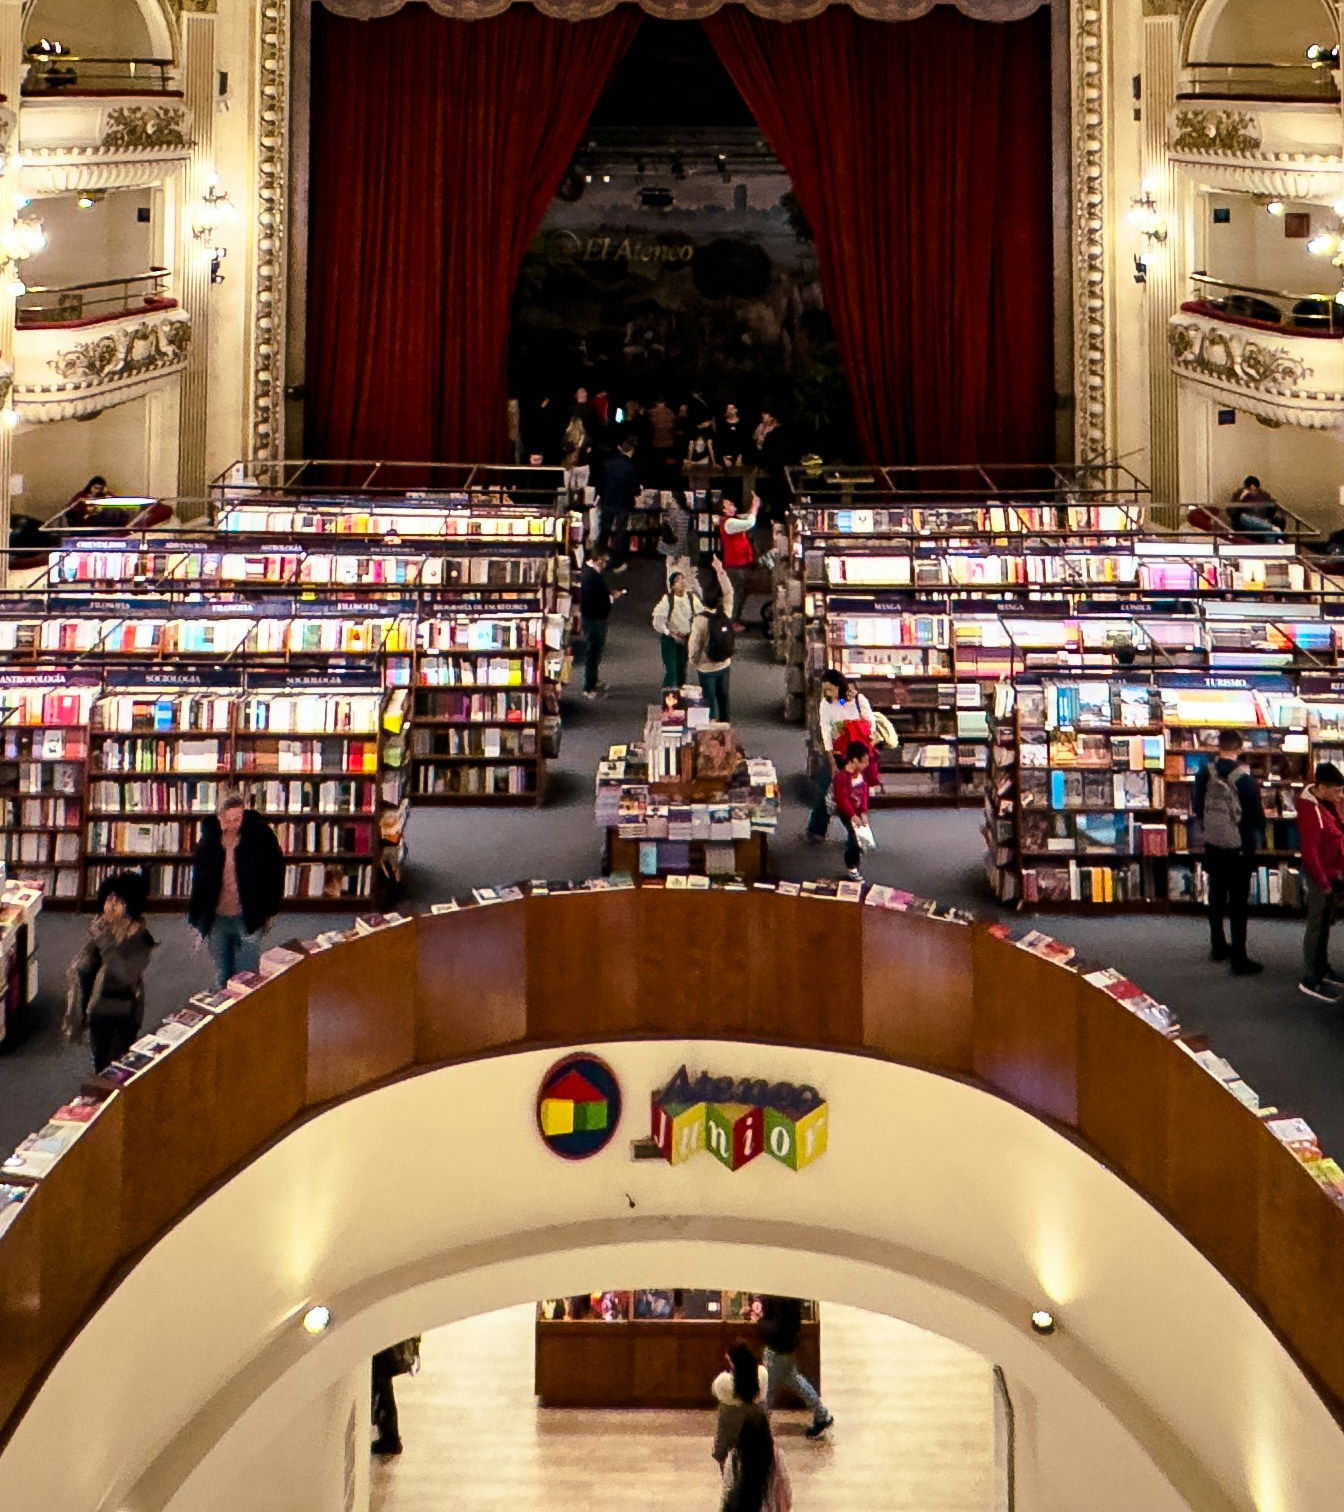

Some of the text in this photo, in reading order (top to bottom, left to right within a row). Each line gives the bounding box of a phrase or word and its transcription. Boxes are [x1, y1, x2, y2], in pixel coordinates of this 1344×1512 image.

[582, 236, 695, 262] El Ateneo
[1204, 676, 1248, 688] TURISMO
[654, 1109, 826, 1159] Junior
